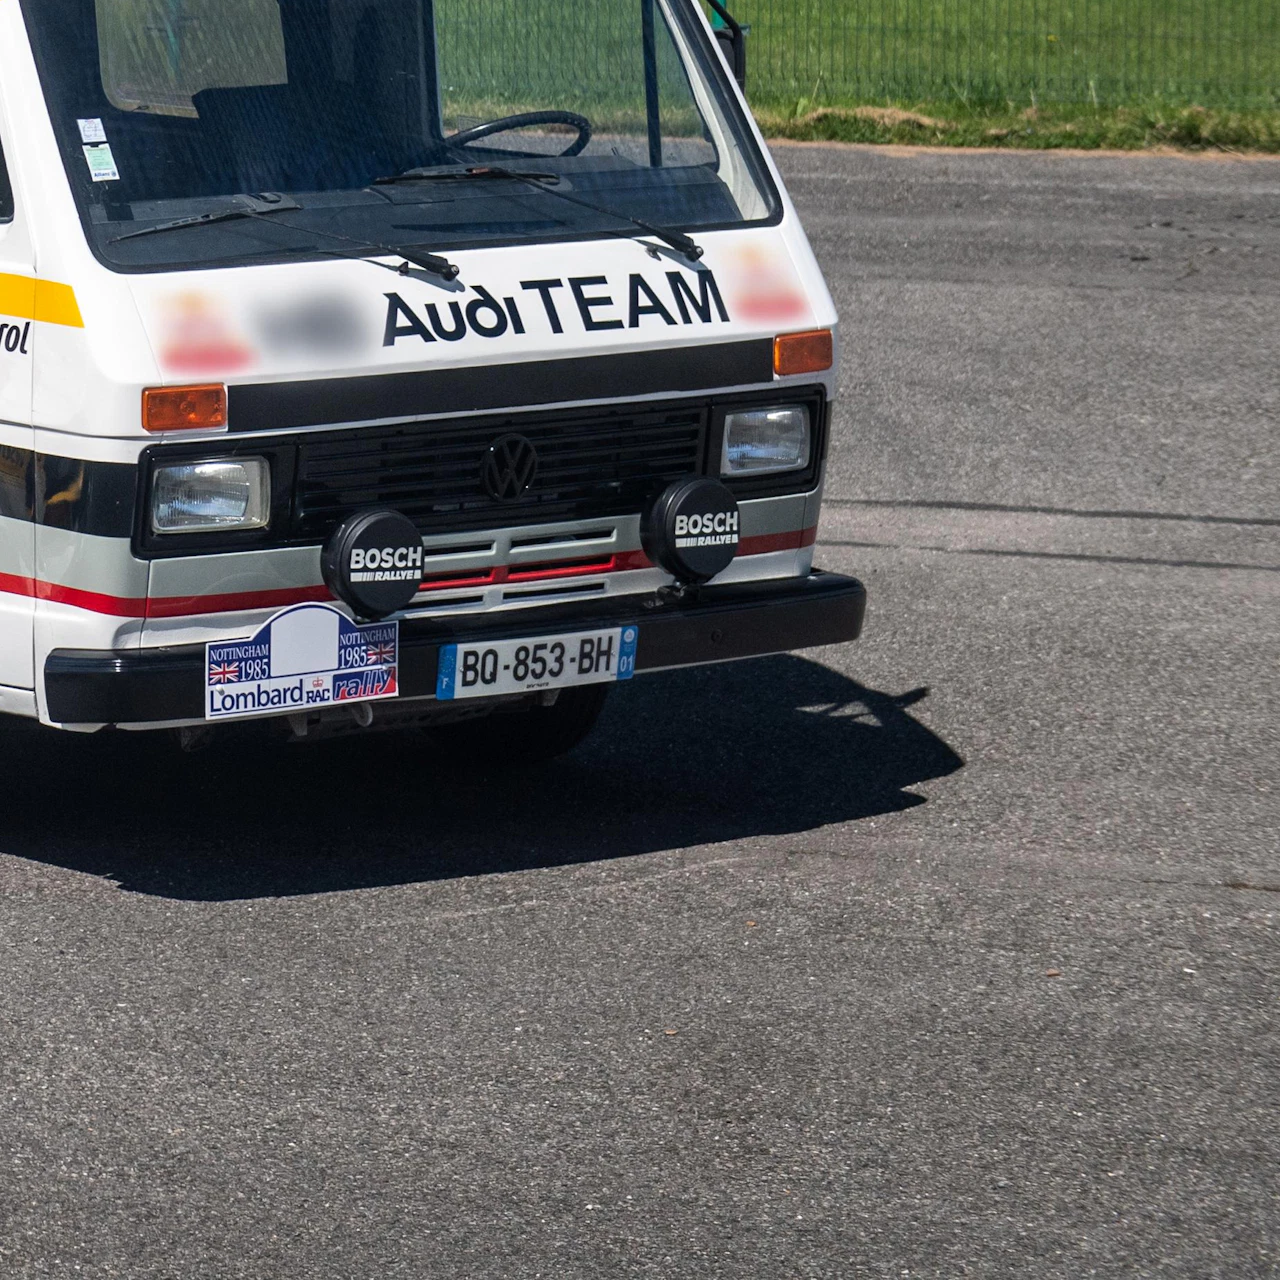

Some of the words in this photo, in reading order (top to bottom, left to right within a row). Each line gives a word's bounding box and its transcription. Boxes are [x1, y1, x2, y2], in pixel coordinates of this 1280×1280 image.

[383, 285, 526, 347] Audi
[519, 270, 731, 334] TEAM
[675, 511, 738, 535] BOSCH
[697, 535, 731, 546] RALLYE
[350, 546, 422, 569] BOSCH
[374, 570, 414, 581] RALLYE
[340, 628, 395, 646] NOTTINGHAM
[210, 644, 269, 662] NOTTINGHAM
[340, 646, 367, 669] 1985
[461, 636, 613, 687] BQ-853-BH
[620, 655, 634, 672] 01
[240, 659, 269, 681] 1985
[210, 679, 304, 713] Lombard
[306, 688, 330, 704] RAC
[334, 669, 393, 701] rally
